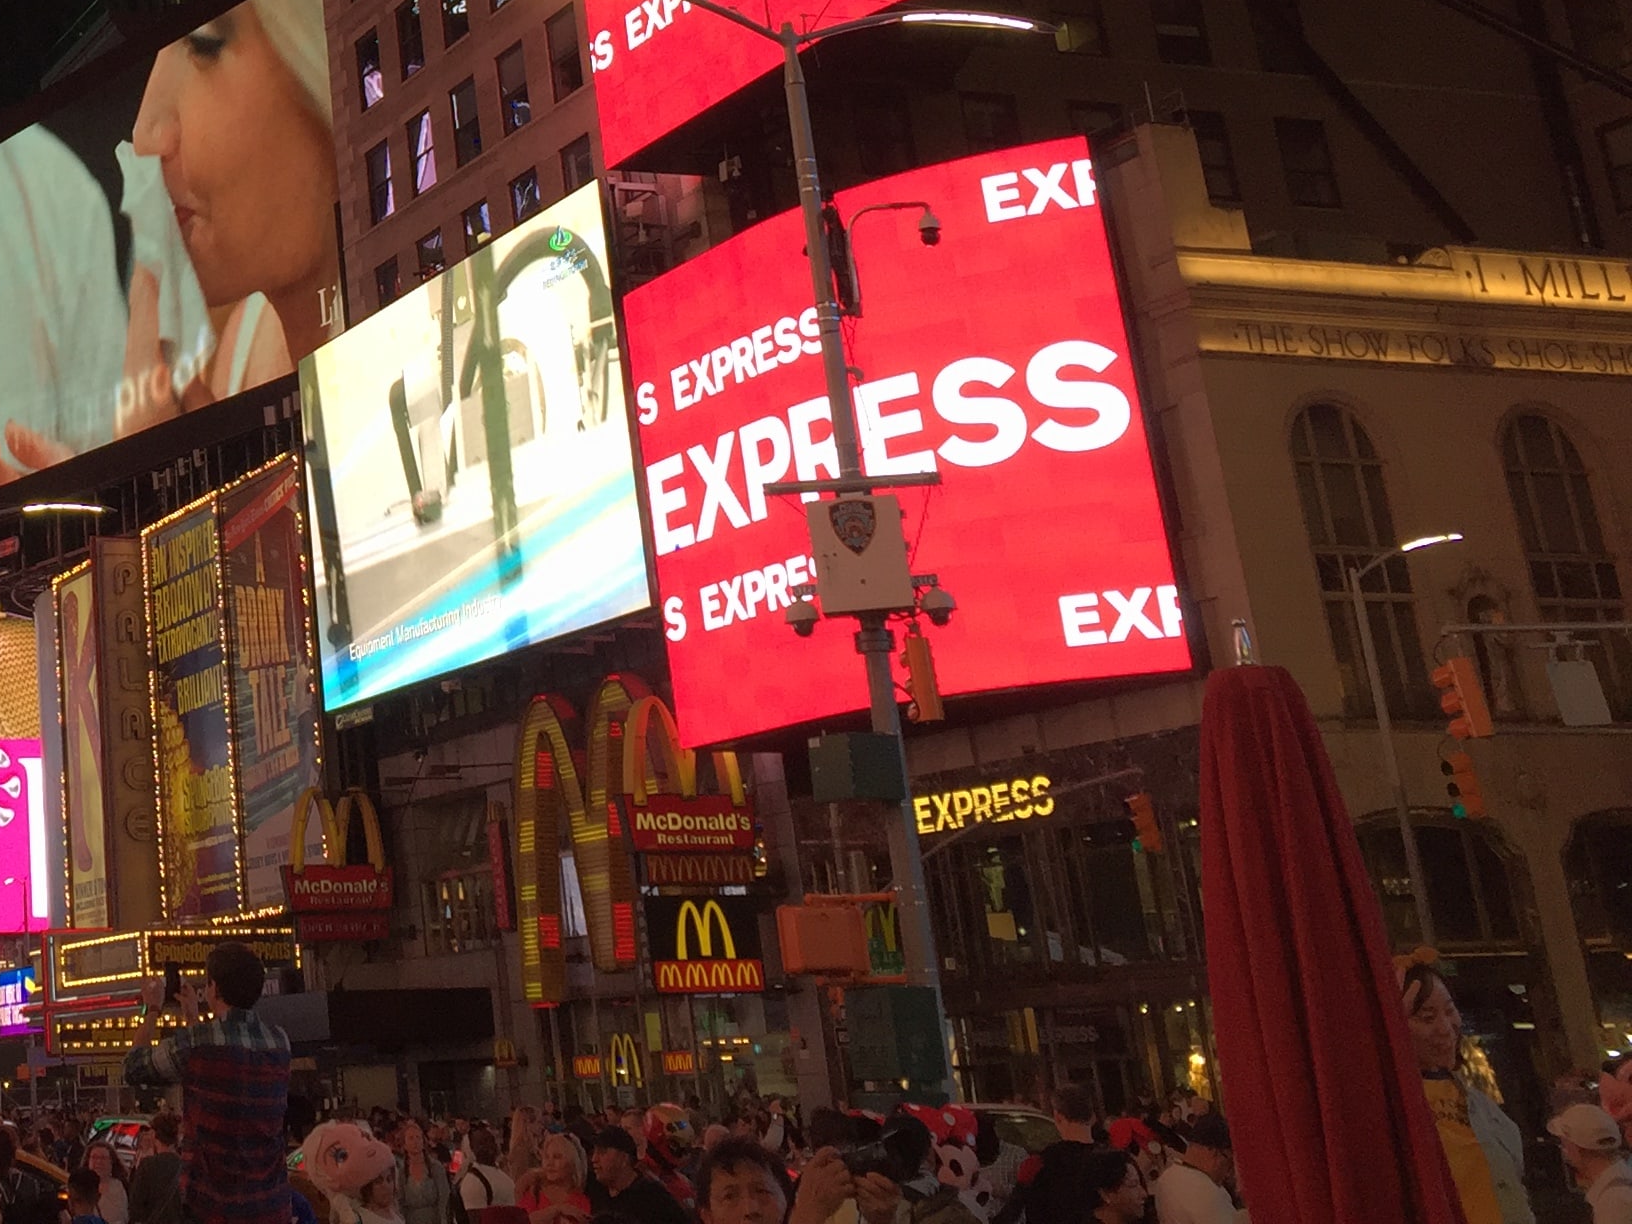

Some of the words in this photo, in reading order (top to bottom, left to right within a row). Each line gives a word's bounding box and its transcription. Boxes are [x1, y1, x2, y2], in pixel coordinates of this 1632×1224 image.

[1237, 323, 1299, 355] THE
[1308, 326, 1391, 361] SHOW
[1506, 337, 1585, 371] SHOE
[637, 382, 658, 424] S
[645, 341, 1131, 556] EXPRESS
[349, 628, 394, 662] Equipment
[396, 608, 462, 649] Manufacturing
[664, 597, 686, 641] S
[113, 561, 152, 842] PALACE
[636, 812, 752, 831] McDonald's
[913, 775, 1055, 836] EXPRESS
[657, 833, 735, 845] Restaurant
